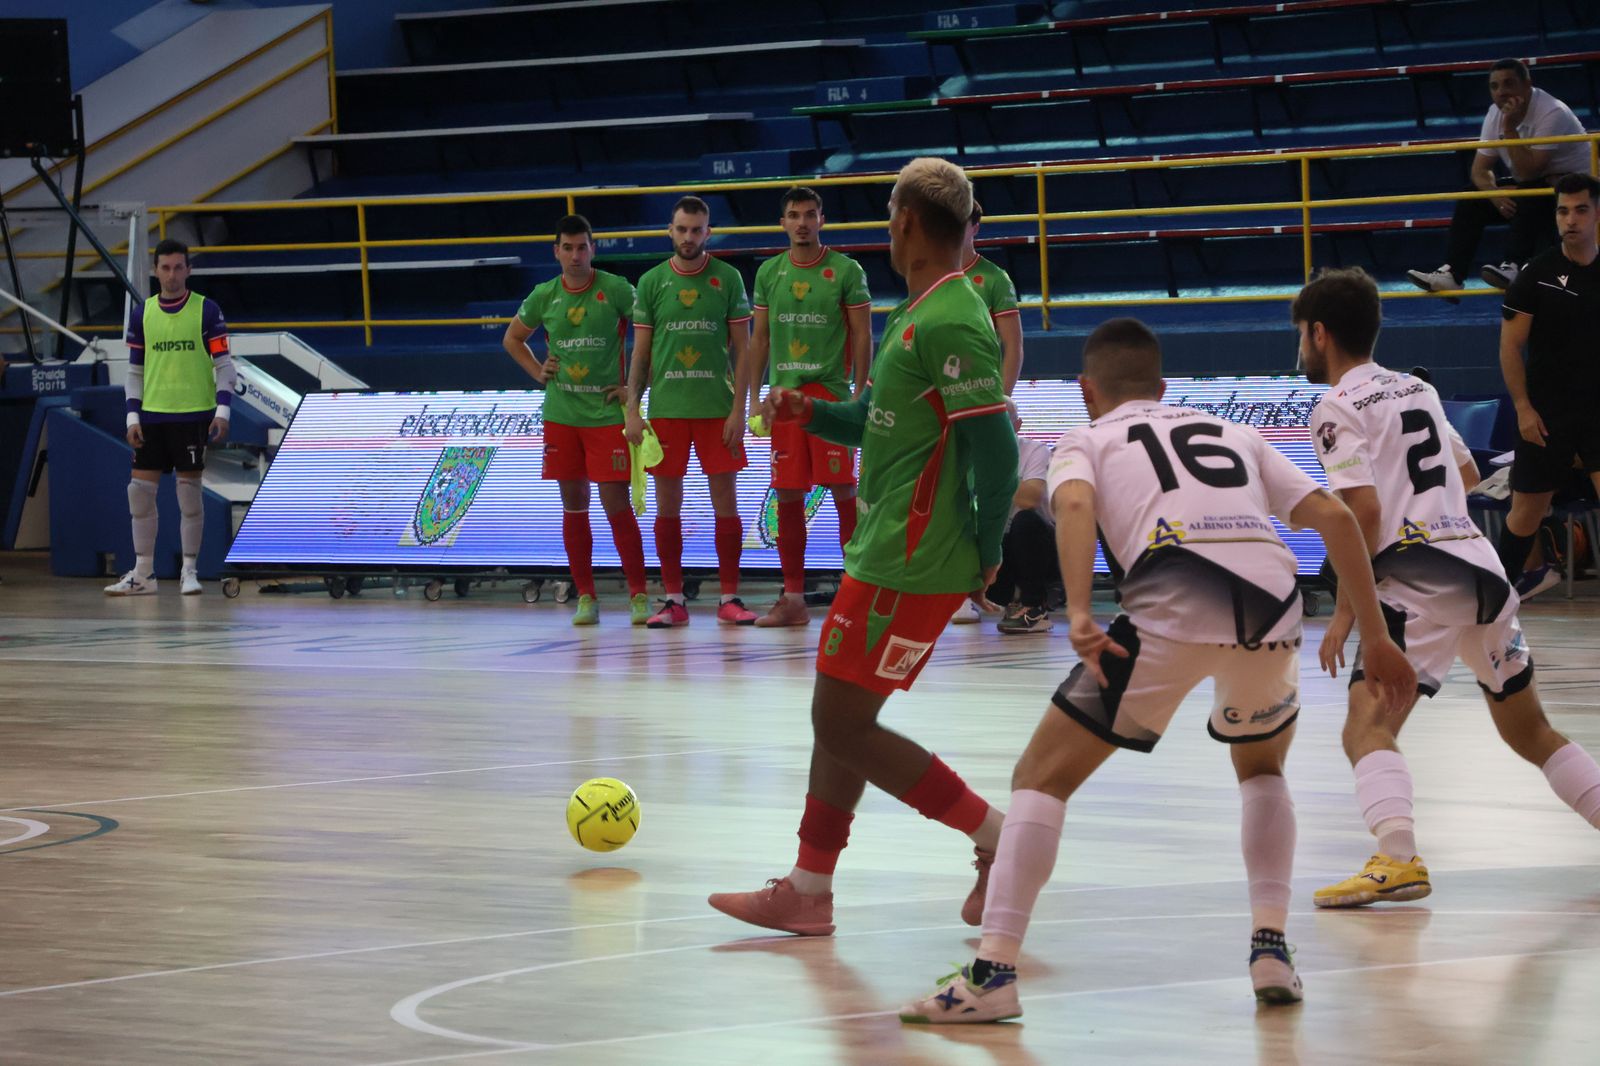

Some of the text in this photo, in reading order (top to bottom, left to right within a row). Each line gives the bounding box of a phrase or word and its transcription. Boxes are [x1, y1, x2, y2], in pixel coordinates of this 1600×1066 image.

[665, 318, 718, 331] euronics
[777, 312, 828, 324] euronics
[556, 334, 607, 348] euronics
[32, 379, 66, 392] Sports
[190, 450, 196, 464] 1
[1128, 422, 1249, 493] 16
[1400, 409, 1446, 495] 2
[611, 454, 627, 472] 10
[1188, 522, 1233, 532] ALBINO
[825, 627, 843, 656] 8
